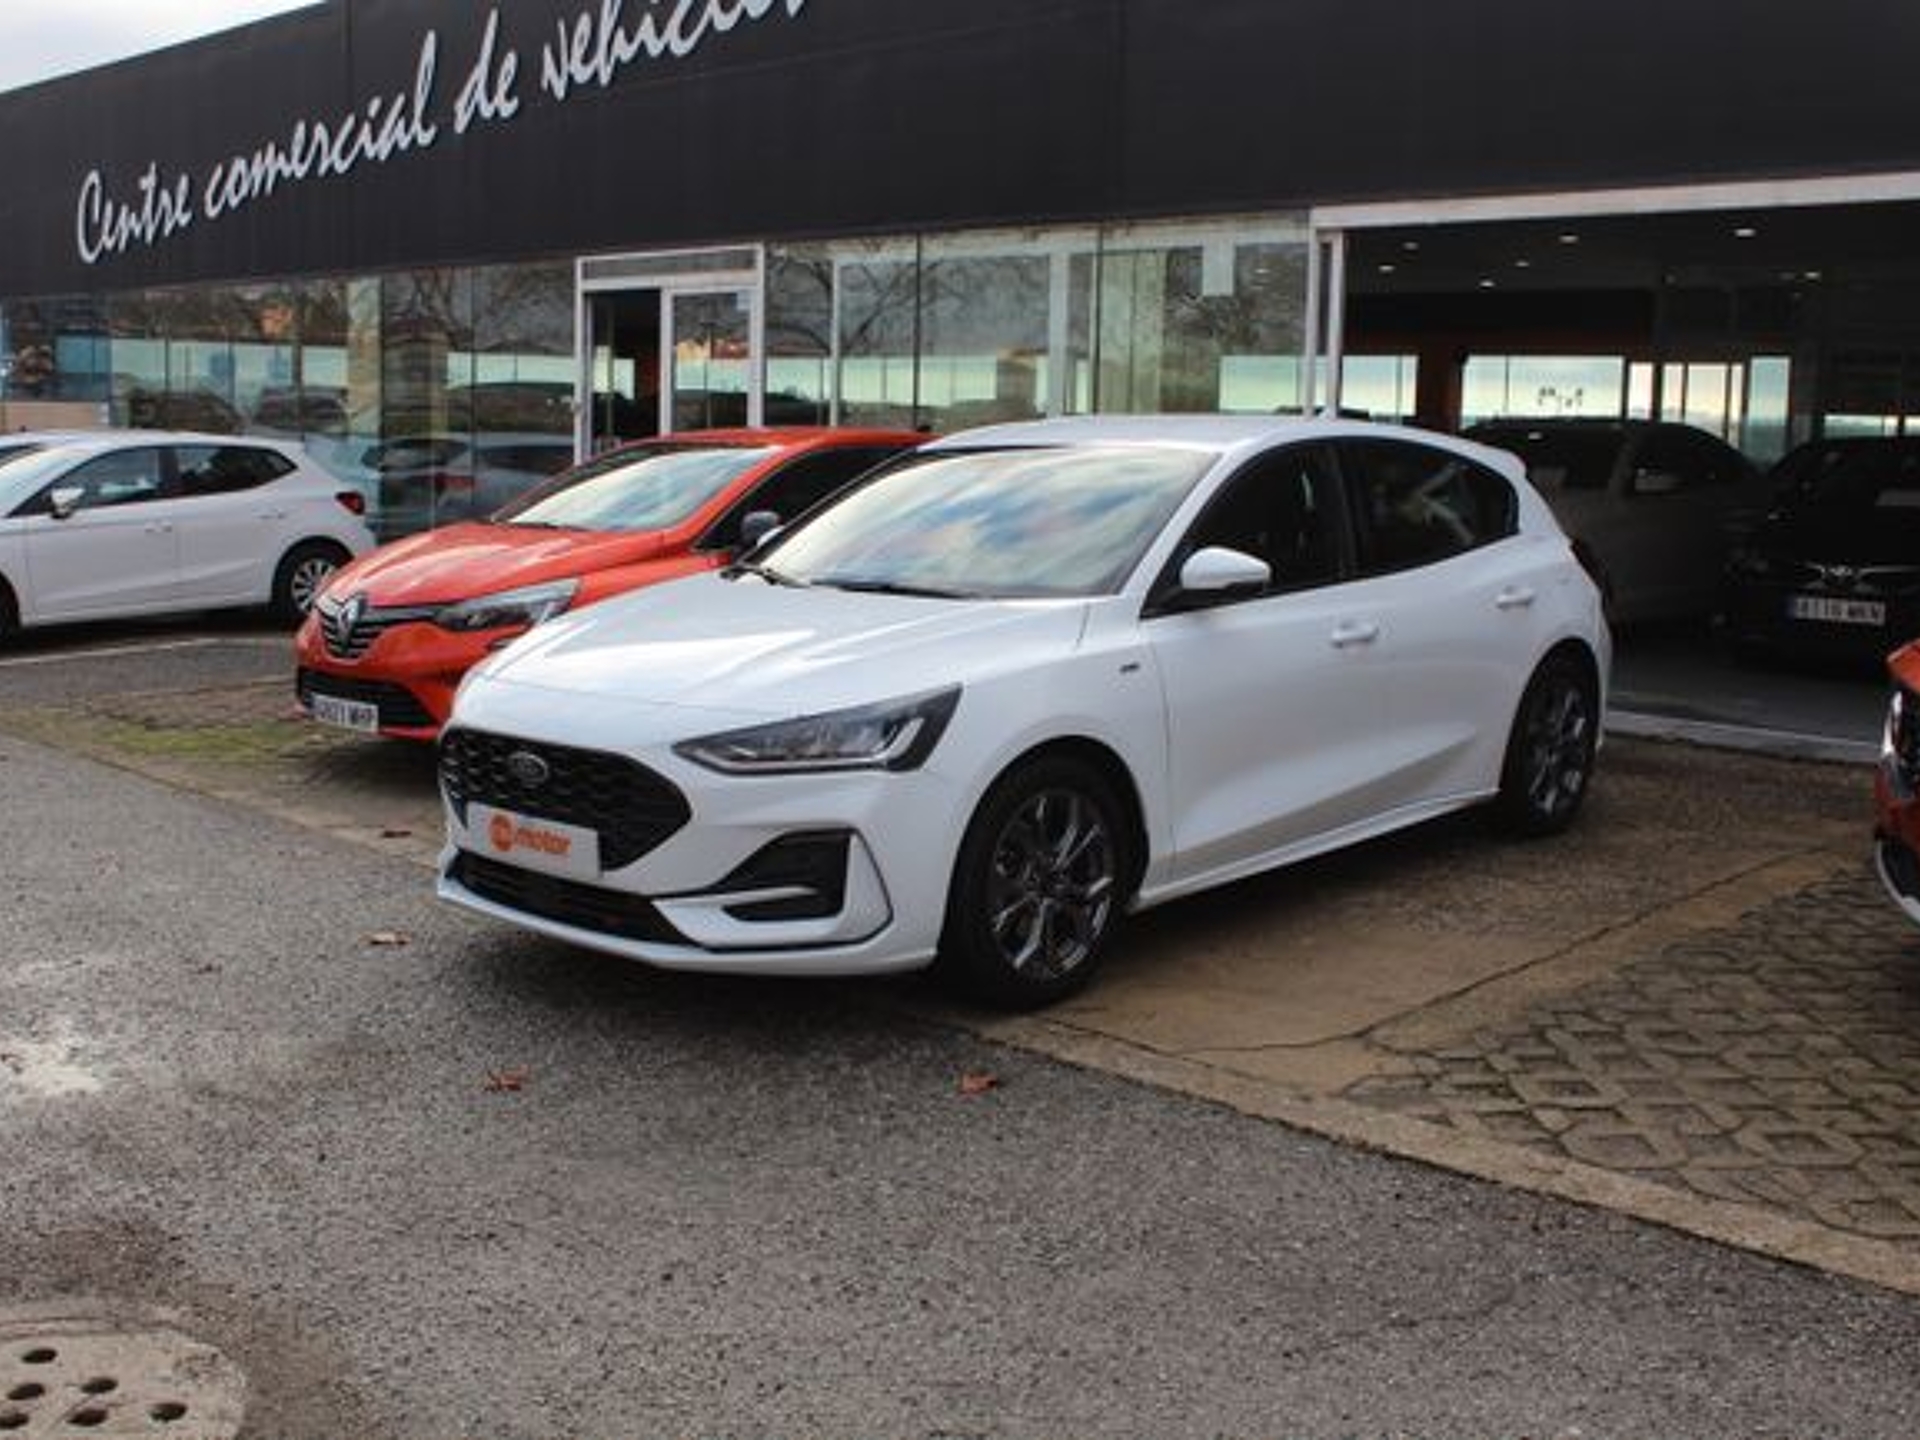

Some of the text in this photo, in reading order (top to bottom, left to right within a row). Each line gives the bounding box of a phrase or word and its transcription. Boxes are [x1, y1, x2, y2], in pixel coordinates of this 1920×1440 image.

[77, 162, 192, 264] Centre
[204, 28, 437, 219] comercial
[455, 7, 519, 134] de
